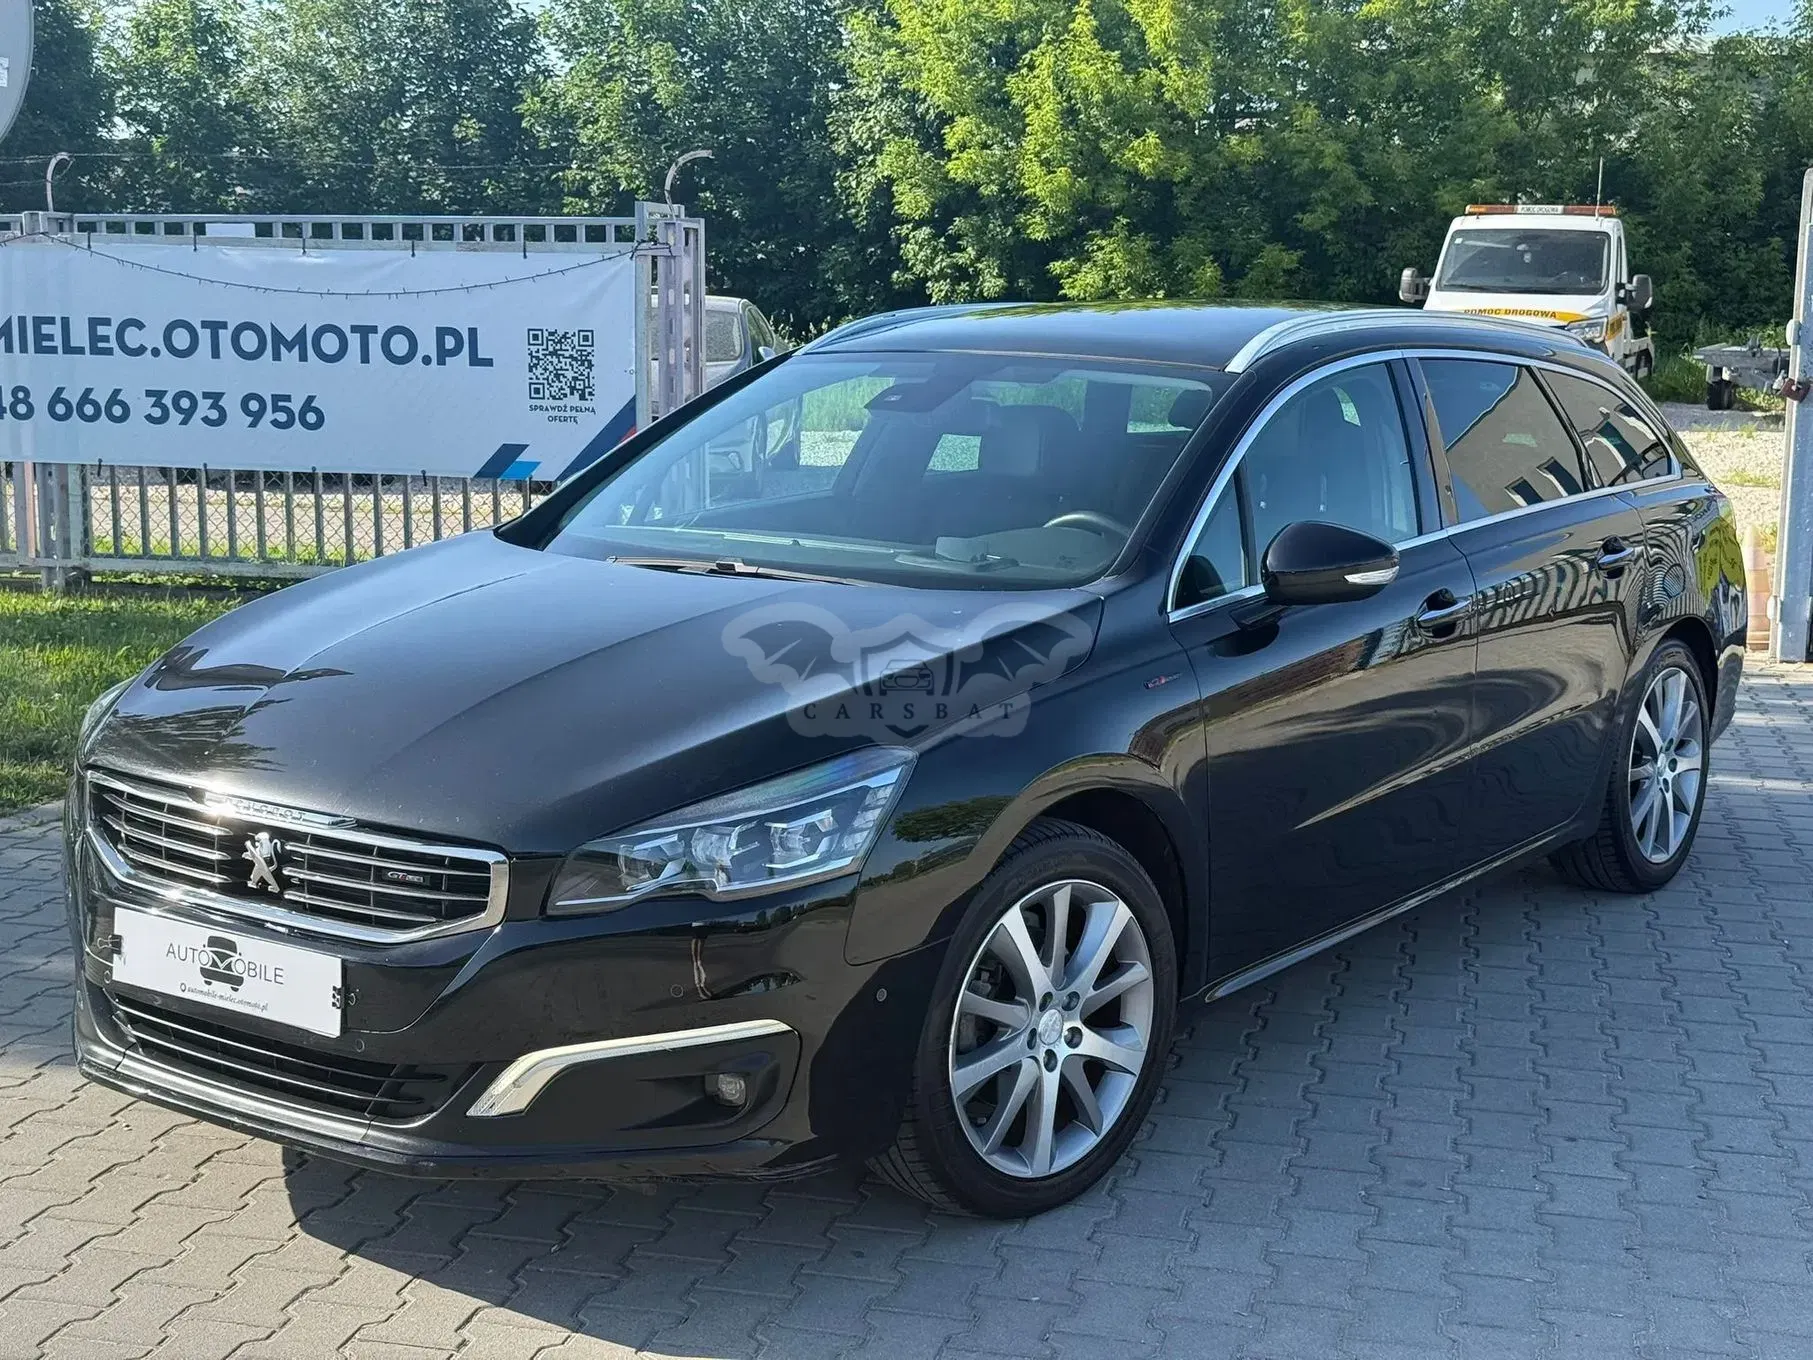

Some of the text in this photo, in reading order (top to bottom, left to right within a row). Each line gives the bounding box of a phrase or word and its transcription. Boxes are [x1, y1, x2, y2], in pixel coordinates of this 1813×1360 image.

[1504, 309, 1557, 319] DROGOWA
[0, 385, 326, 431] 8 666 393 956
[529, 404, 568, 412] SPRAWDŹ
[547, 415, 578, 424] OFERTĘ
